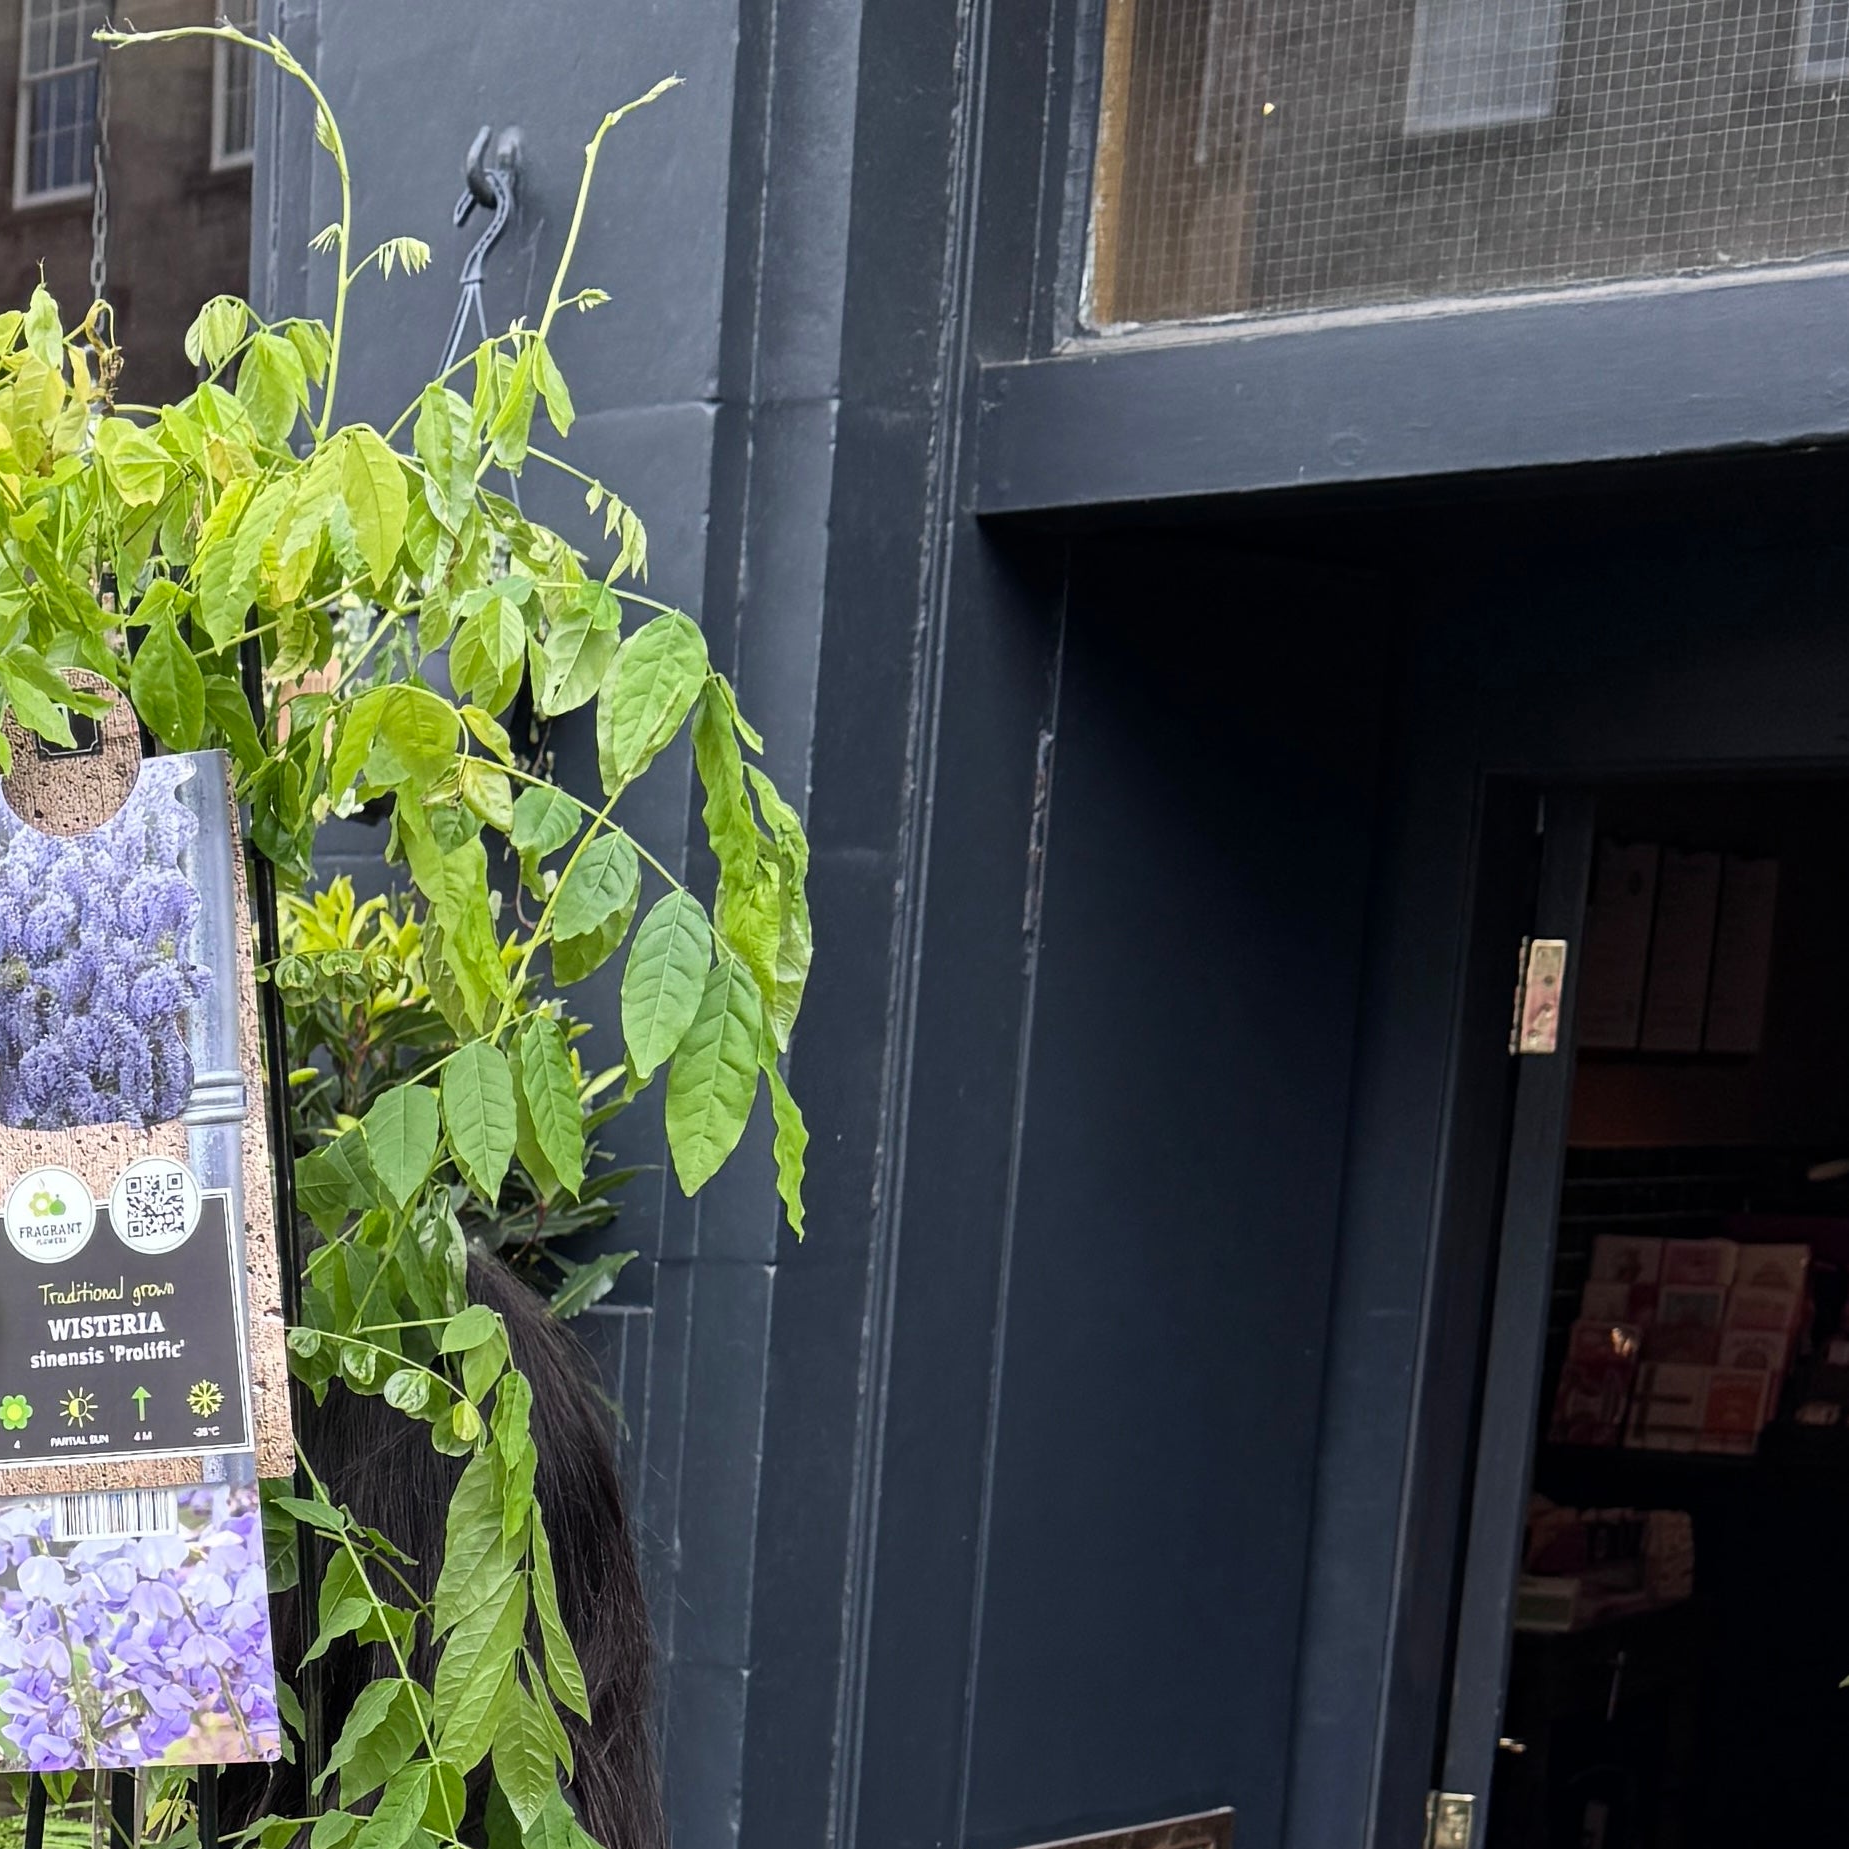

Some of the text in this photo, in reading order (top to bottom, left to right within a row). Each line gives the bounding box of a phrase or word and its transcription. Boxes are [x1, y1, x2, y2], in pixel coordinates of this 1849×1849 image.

[19, 1222, 82, 1238] FRAGRANT
[38, 1275, 175, 1307] Traditional grown
[47, 1311, 166, 1342] WISTERIA
[30, 1339, 185, 1369] sinensis 'Prolific'
[13, 1440, 21, 1450] 4
[50, 1434, 110, 1448] PARTIAL SUN
